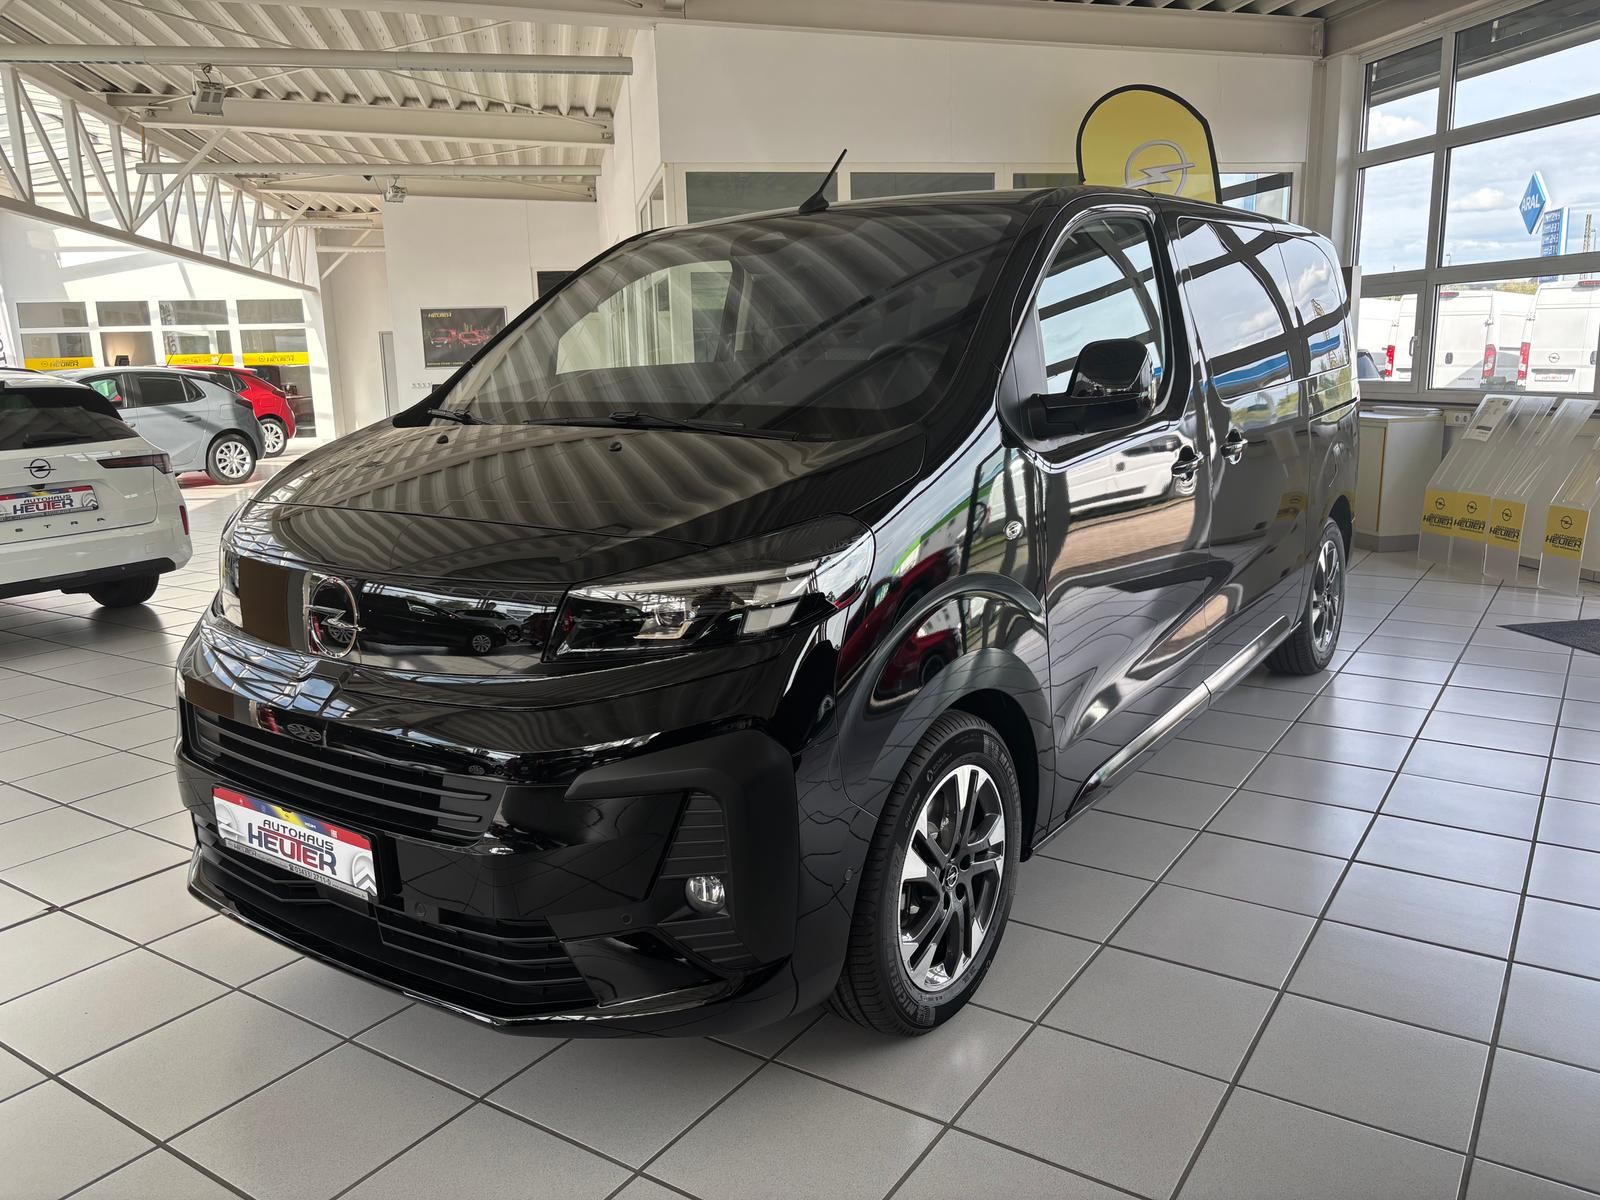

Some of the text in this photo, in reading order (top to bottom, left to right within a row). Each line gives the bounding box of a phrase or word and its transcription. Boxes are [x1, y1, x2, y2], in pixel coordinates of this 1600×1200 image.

[1521, 193, 1541, 211] ARAL
[24, 494, 72, 504] AUTOHAUS
[13, 499, 74, 514] HEUTER
[1453, 518, 1486, 531] HEUTER
[1488, 526, 1520, 540] HEUTER
[1545, 535, 1583, 549] HEUTER
[263, 819, 334, 851] AUTOHAUS
[248, 823, 337, 875] HEUTER
